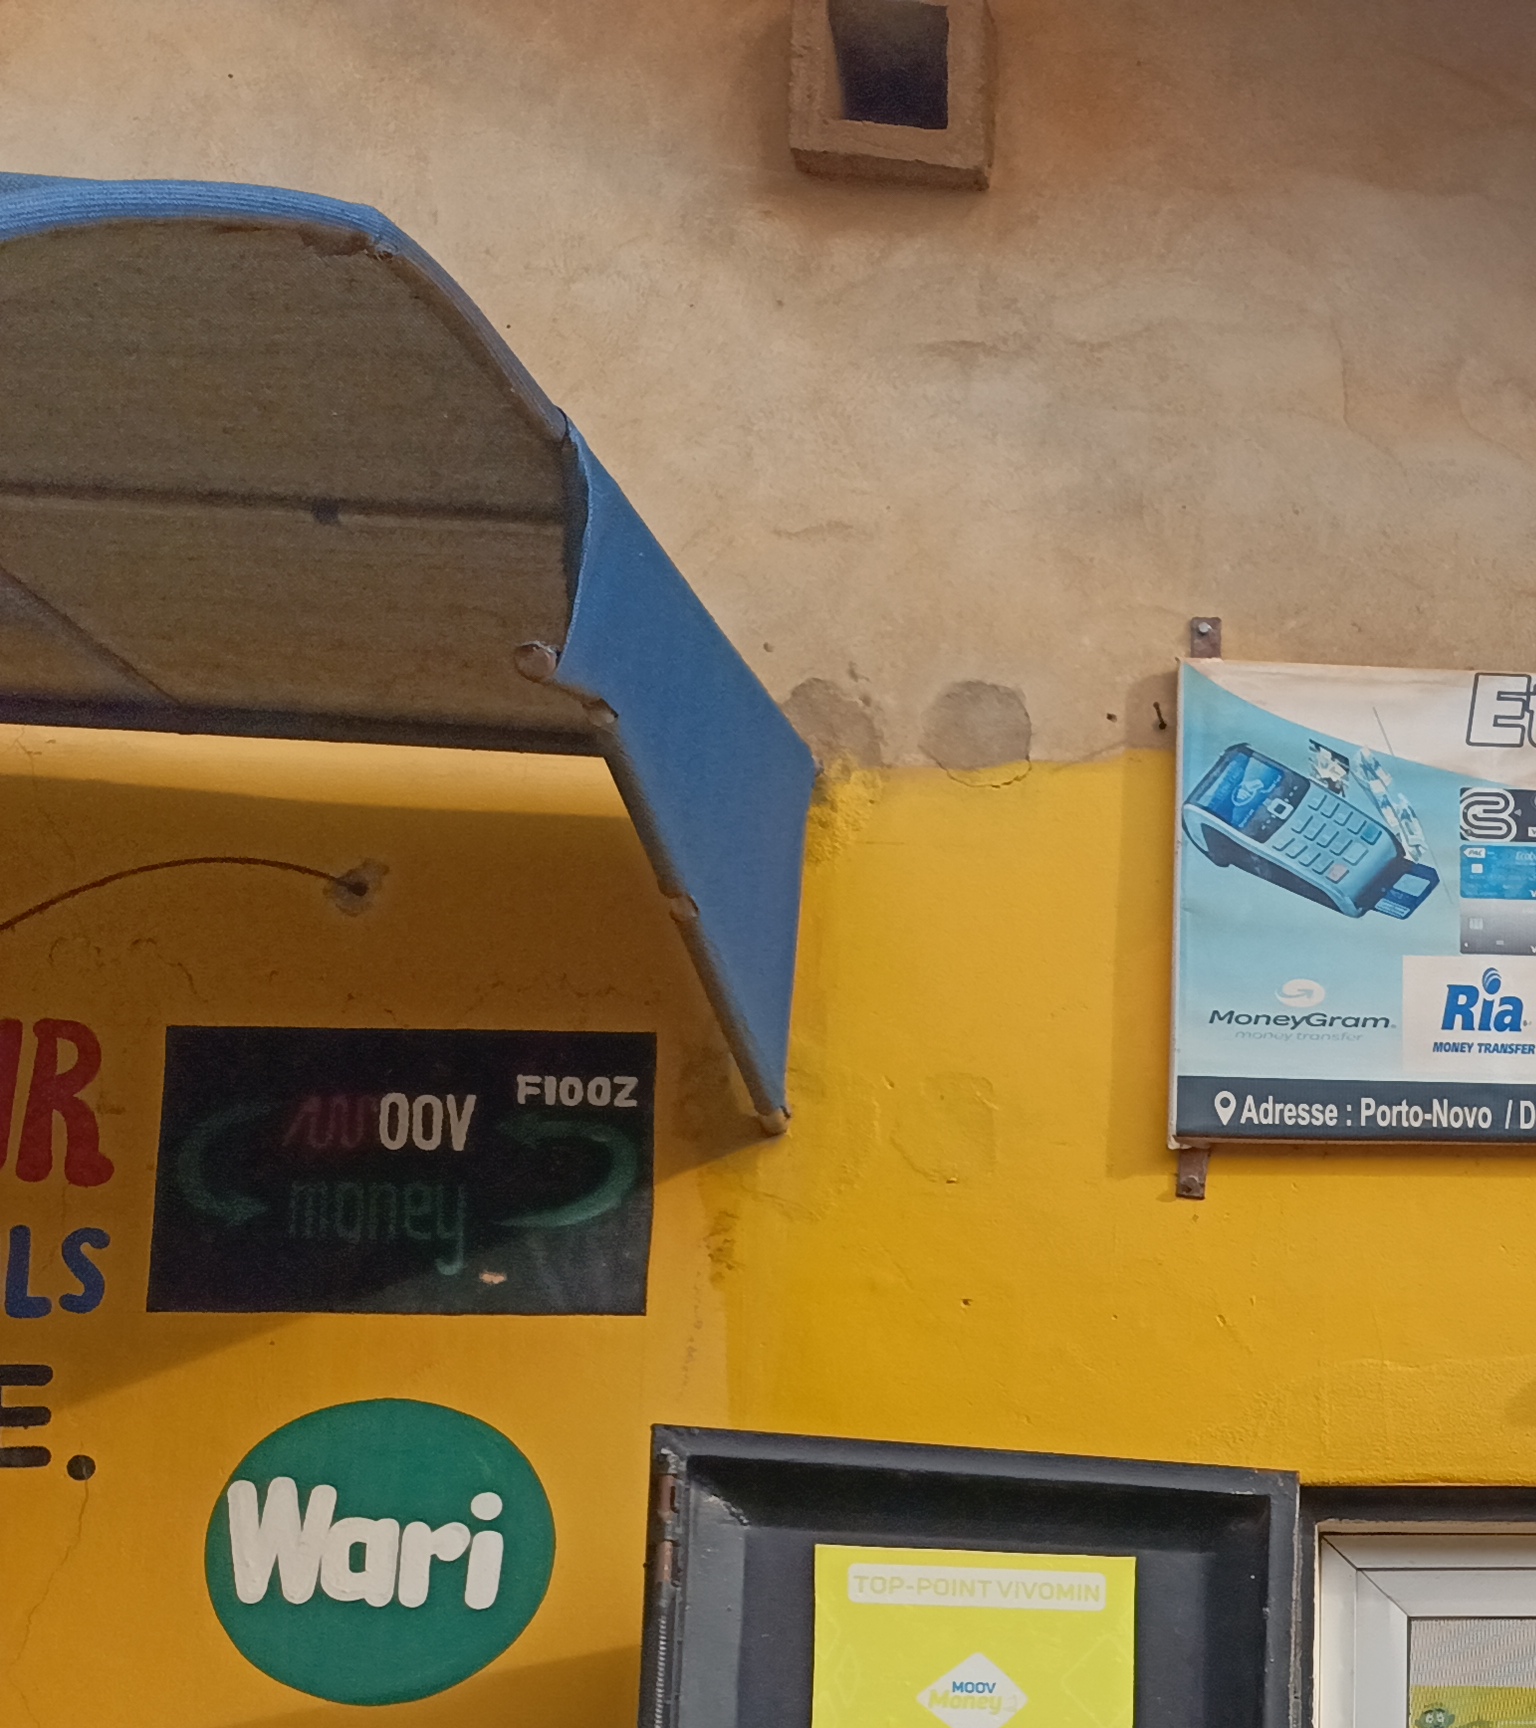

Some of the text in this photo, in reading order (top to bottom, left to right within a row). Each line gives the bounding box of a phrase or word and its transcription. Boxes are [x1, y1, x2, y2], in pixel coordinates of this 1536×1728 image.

[1441, 967, 1524, 1032] Ria
[1208, 1009, 1390, 1029] MoneyGram
[1235, 1030, 1363, 1042] money transfer
[1433, 1041, 1535, 1055] MONEY TRANSFER
[1240, 1095, 1338, 1127] Adresse
[1360, 1097, 1493, 1129] Porto-Novo
[227, 1476, 504, 1610] Wari
[853, 1575, 991, 1600] TOP-POINT
[951, 1680, 996, 1694] MOOV
[927, 1690, 1002, 1714] Money
